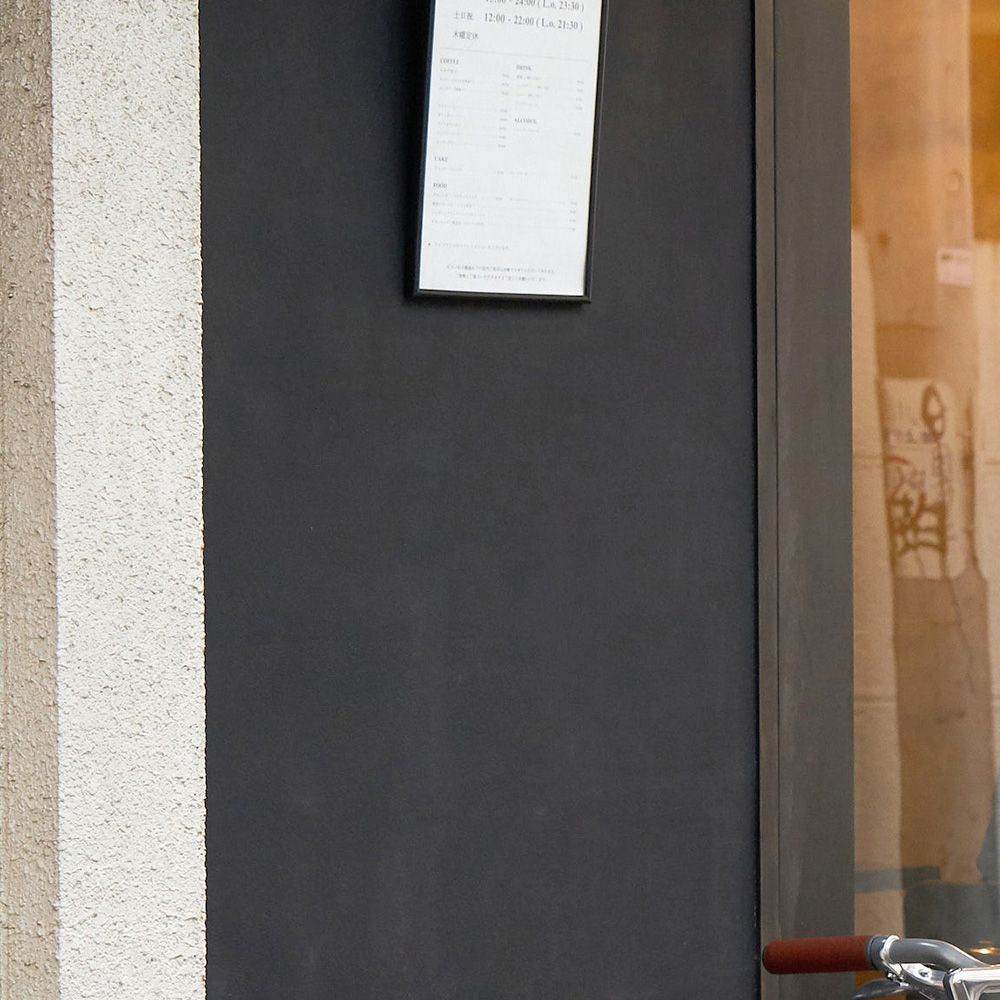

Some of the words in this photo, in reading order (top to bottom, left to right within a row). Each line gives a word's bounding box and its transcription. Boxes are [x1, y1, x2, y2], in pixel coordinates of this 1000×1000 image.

[484, 12, 505, 24] 12:00
[514, 15, 535, 26] 22:00
[558, 18, 579, 31] 21:30
